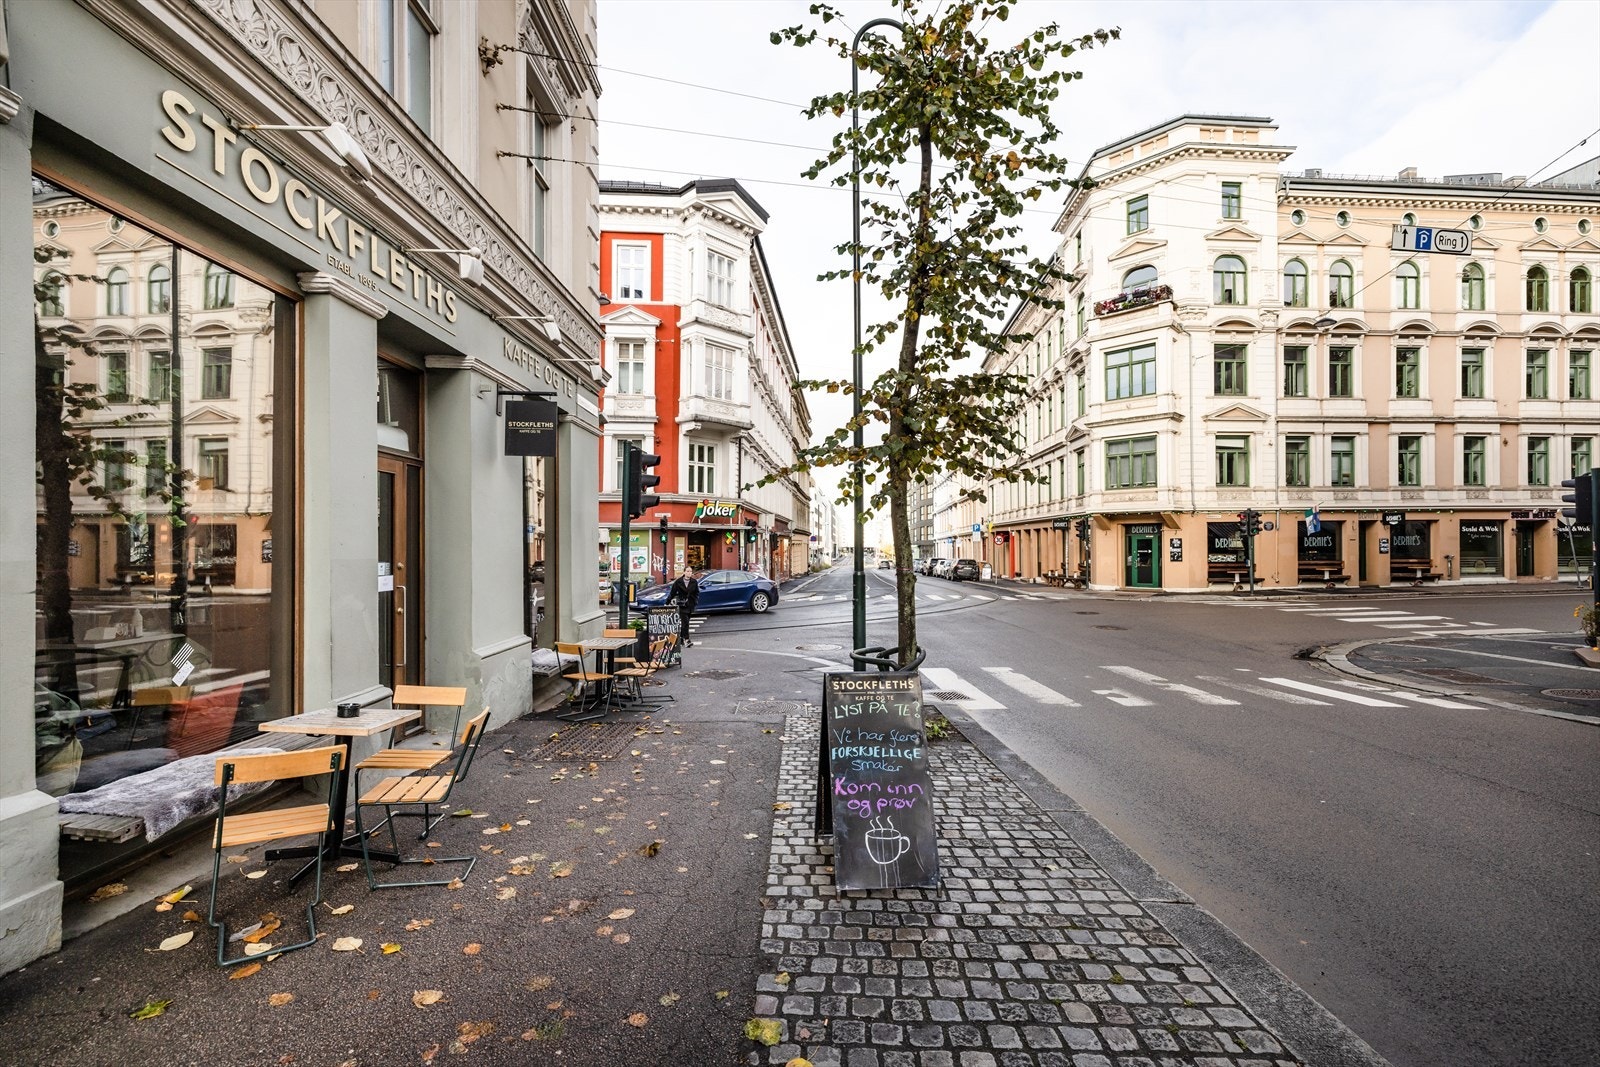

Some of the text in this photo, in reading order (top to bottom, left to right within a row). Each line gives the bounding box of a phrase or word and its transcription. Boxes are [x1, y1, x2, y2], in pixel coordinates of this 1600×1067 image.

[161, 89, 458, 323] STOCKFLETHS
[1438, 235, 1457, 249] Ring
[1460, 236, 1464, 248] 1
[358, 272, 377, 292] 1895
[503, 337, 573, 398] KAFFE OG TE
[699, 499, 736, 519] joker
[1303, 536, 1333, 547] BERNIE'S
[1392, 535, 1421, 546] BERNIE'S
[833, 680, 915, 690] STOCKFLETHS
[833, 702, 864, 719] LYST
[869, 699, 888, 714] PÅ
[832, 726, 919, 748] Vi har flere
[831, 745, 922, 760] FORSKJELLIGE
[834, 776, 924, 796] Kom inn
[847, 797, 917, 818] og prøv
